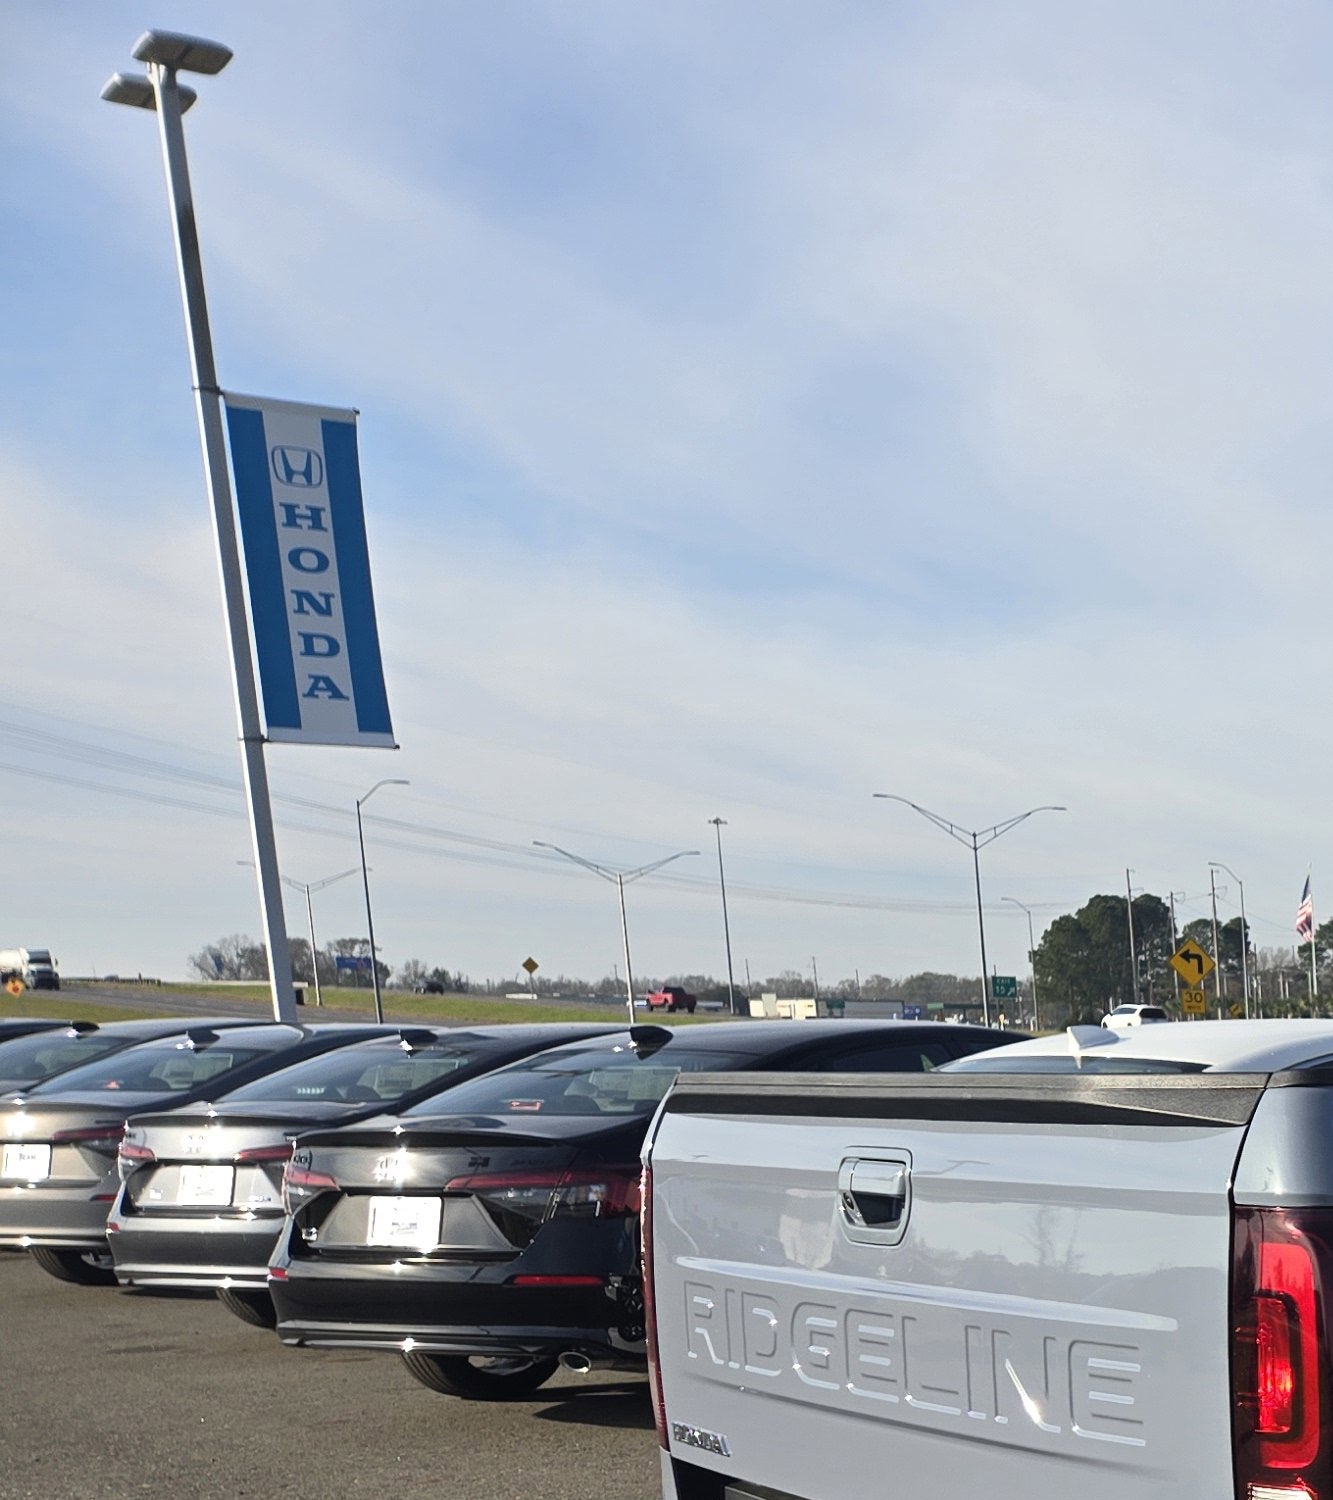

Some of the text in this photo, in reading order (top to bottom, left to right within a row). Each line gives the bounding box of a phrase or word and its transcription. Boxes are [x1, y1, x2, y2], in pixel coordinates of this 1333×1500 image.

[278, 501, 350, 701] HONDA
[1184, 991, 1203, 1003] 30
[682, 1280, 1147, 1447] RIDGELINE
